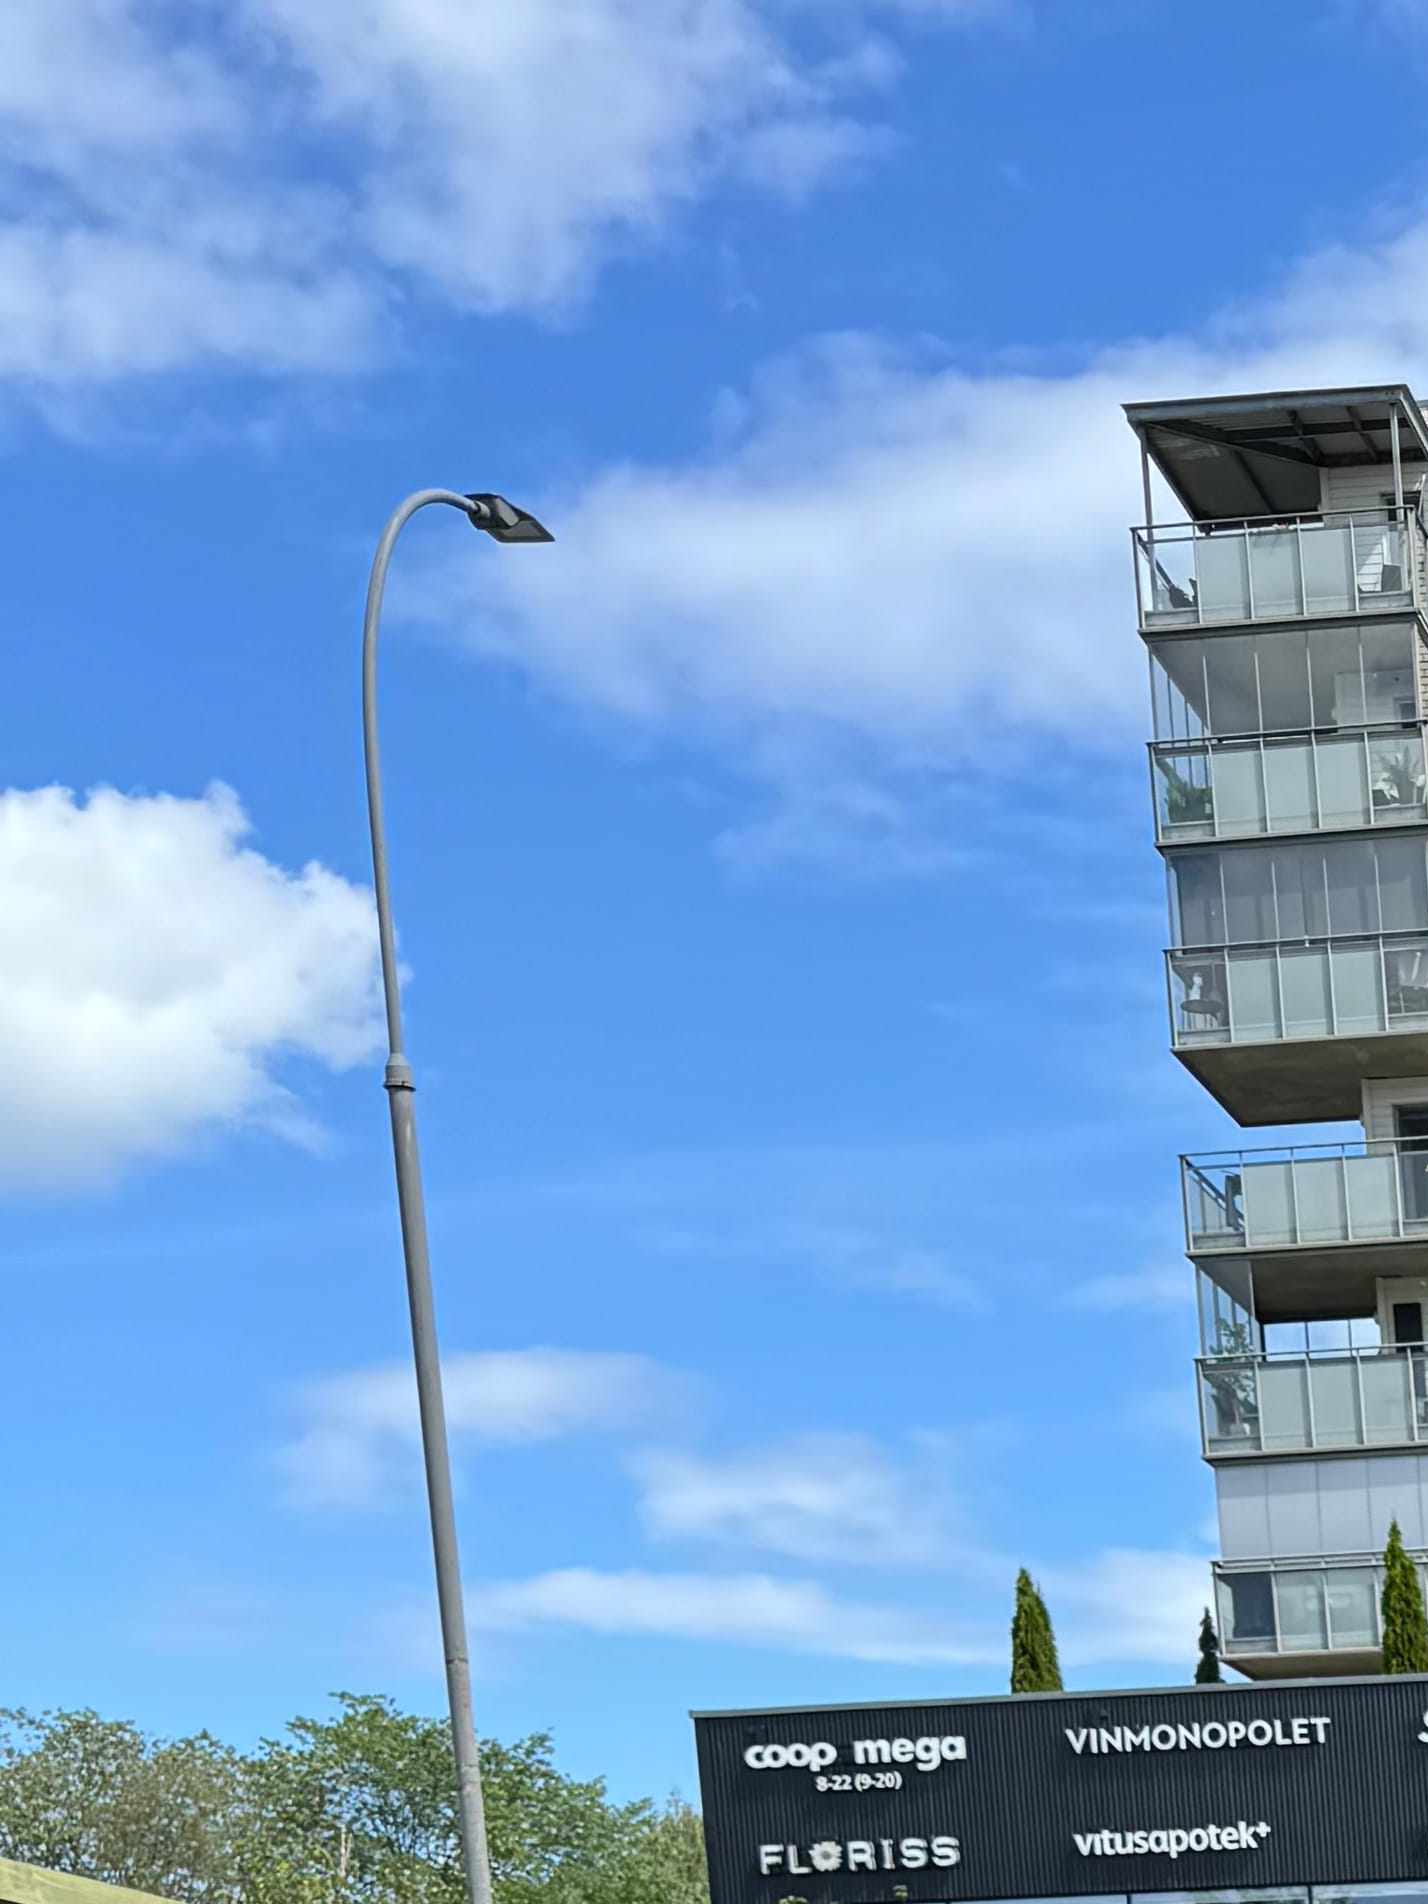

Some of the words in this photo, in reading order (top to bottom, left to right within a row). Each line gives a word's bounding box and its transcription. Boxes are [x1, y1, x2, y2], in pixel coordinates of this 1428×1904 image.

[745, 1742, 838, 1772] coop
[853, 1735, 968, 1771] mega
[1065, 1717, 1331, 1754] VINMONOPOLET
[815, 1775, 853, 1792] 8-22
[855, 1771, 903, 1792] (9-20)
